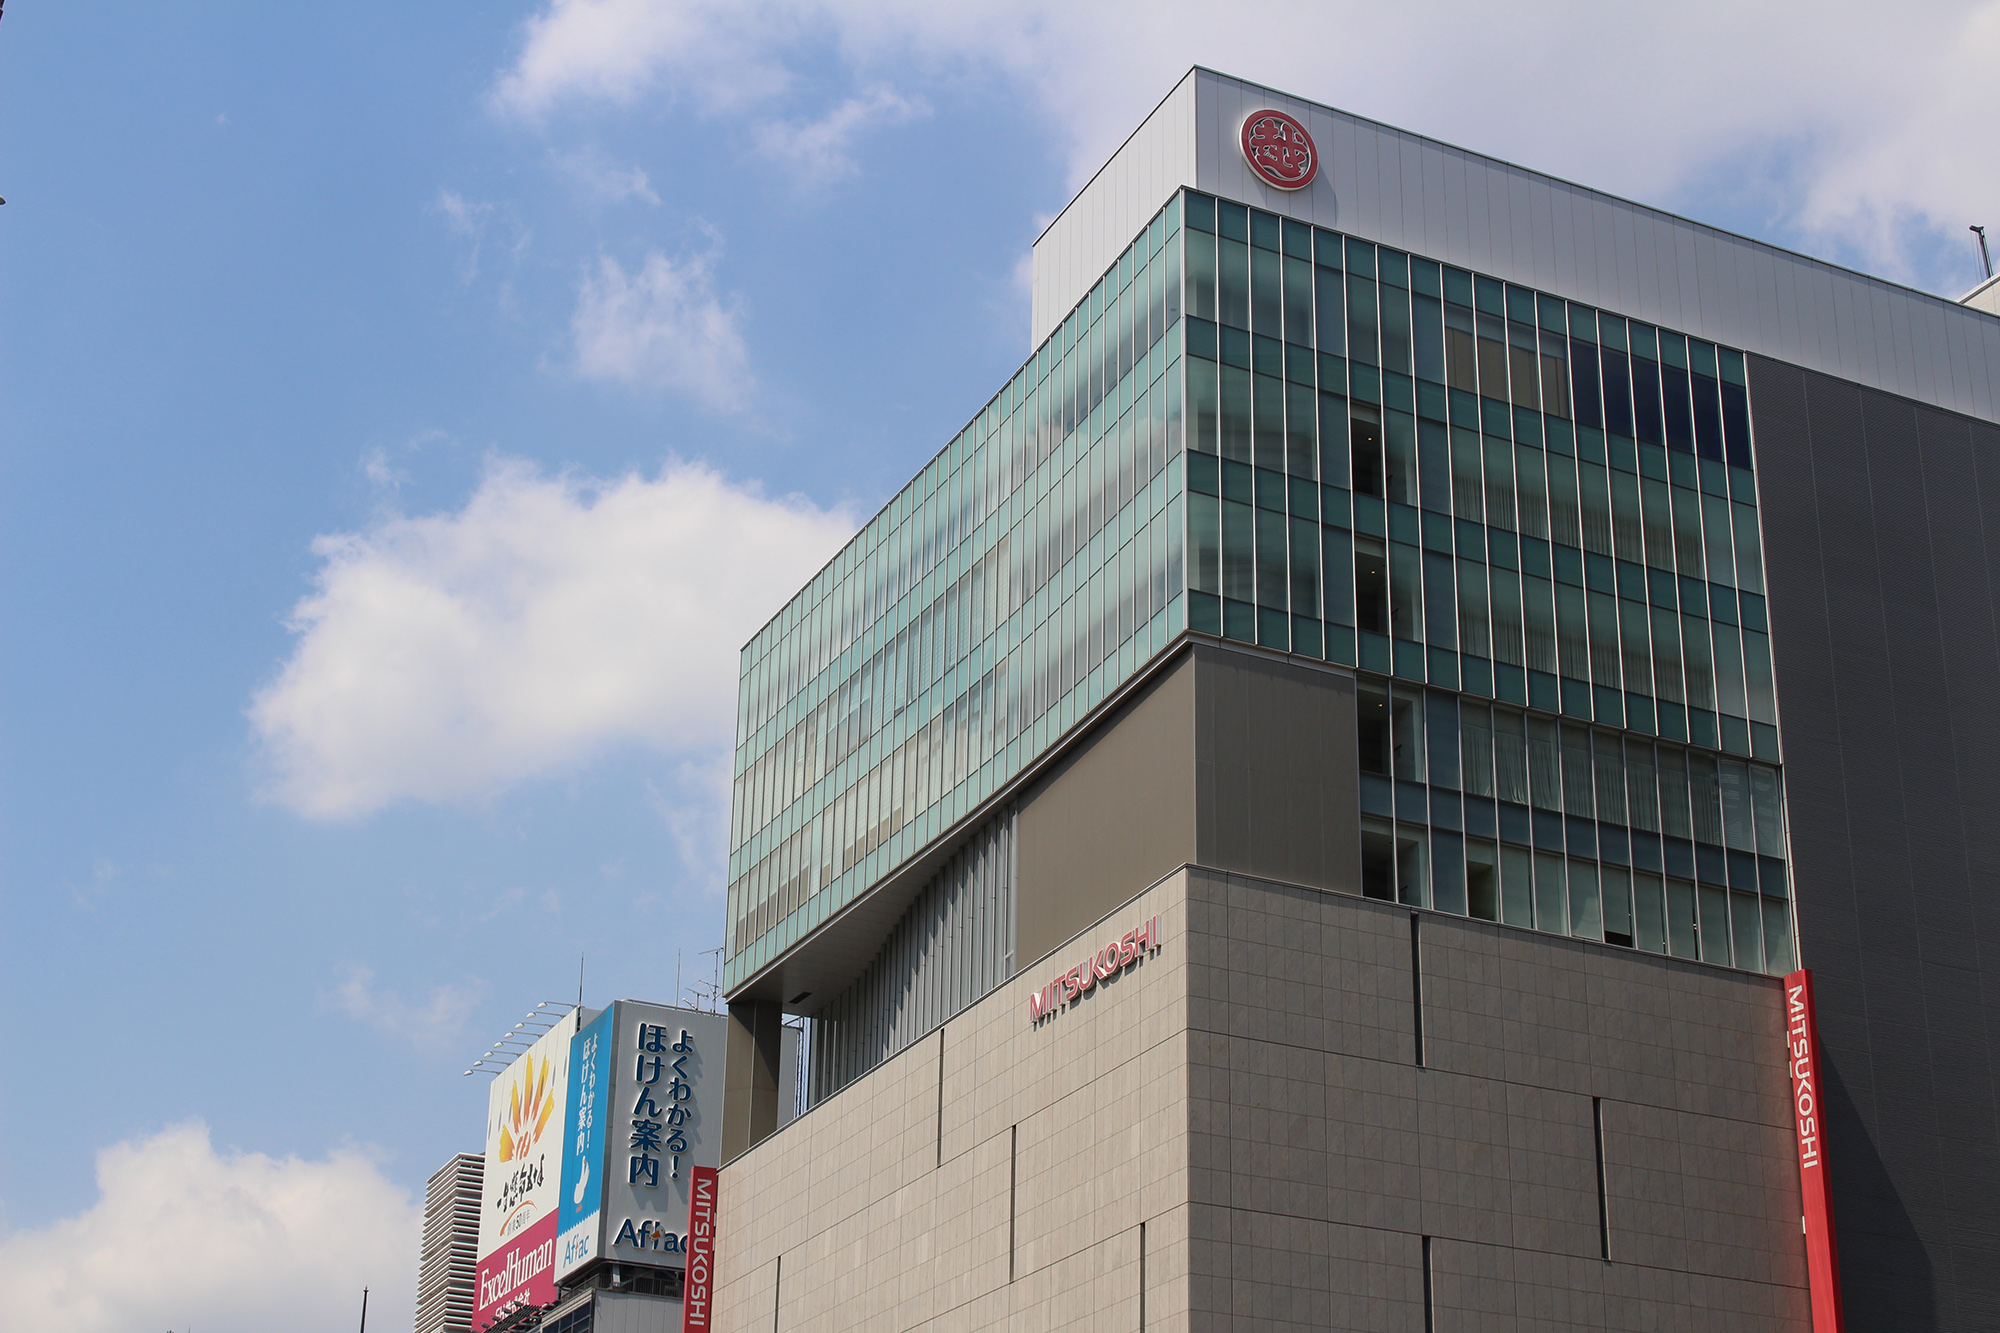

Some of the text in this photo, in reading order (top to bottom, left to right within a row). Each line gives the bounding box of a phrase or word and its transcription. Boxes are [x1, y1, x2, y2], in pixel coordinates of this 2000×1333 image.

[1029, 915, 1159, 1023] MITSUKOSHI
[576, 1038, 591, 1157] ほけん案内
[628, 1022, 667, 1187] ほけん案内
[1788, 984, 1818, 1169] MITSUKOSHI
[689, 1178, 712, 1326] MITSUKOSHI
